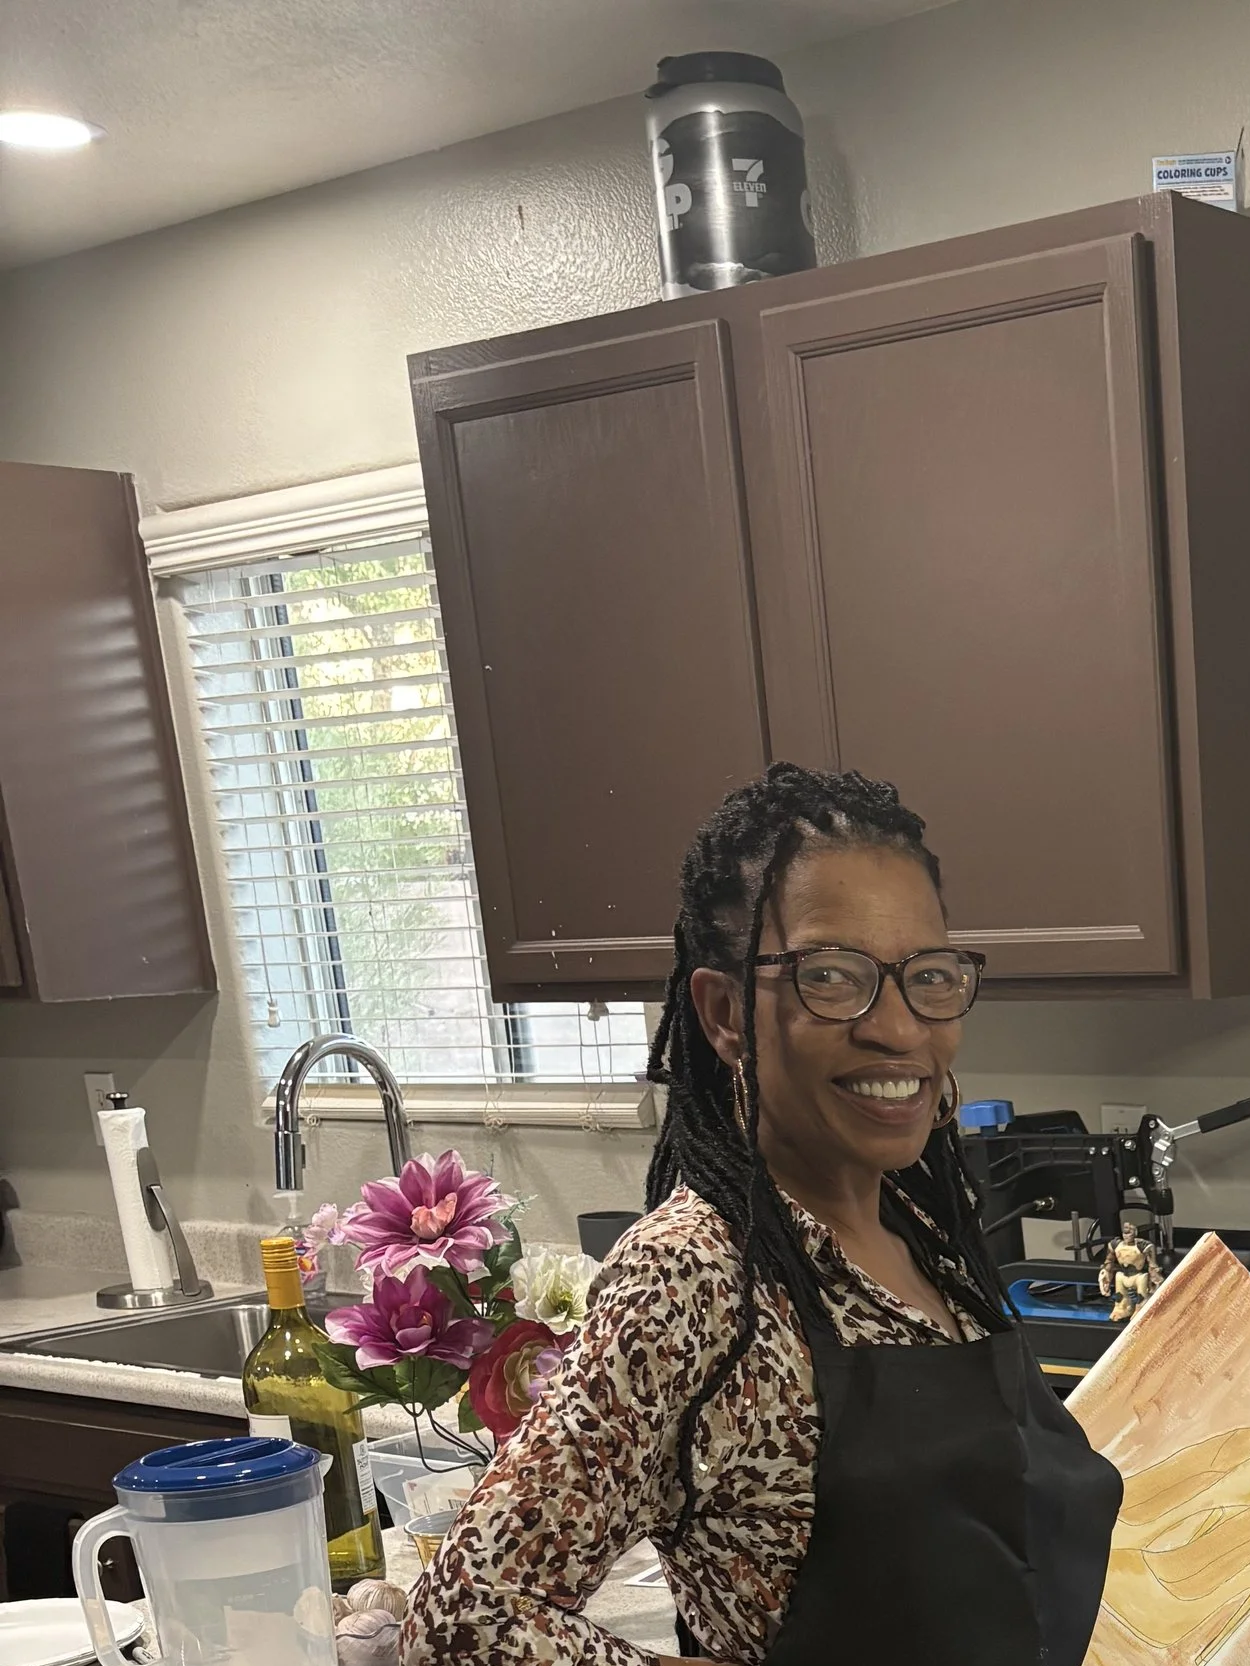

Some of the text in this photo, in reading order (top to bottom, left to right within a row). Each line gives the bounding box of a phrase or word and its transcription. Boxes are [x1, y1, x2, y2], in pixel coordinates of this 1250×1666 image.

[731, 158, 765, 208] 7
[1157, 167, 1229, 180] COLORING CUPS
